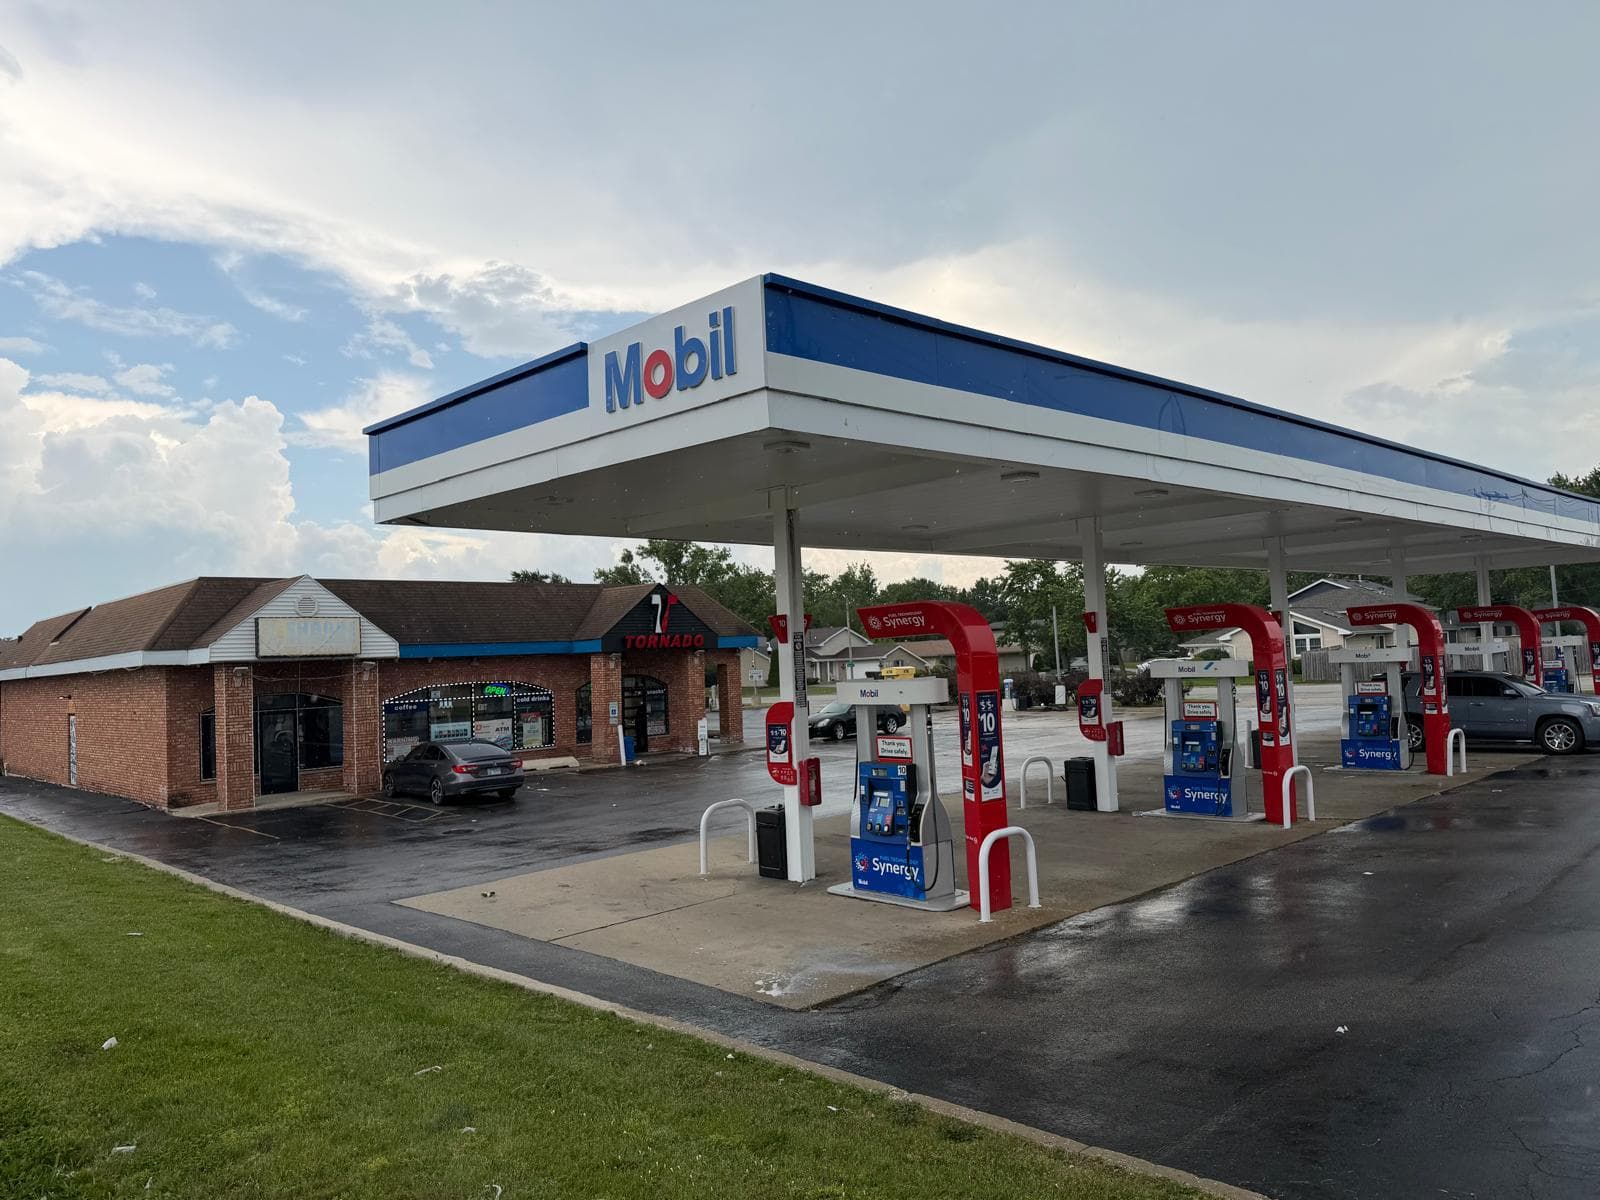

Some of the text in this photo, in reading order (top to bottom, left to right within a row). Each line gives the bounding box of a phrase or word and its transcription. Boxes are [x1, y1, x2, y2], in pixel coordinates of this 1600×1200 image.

[604, 305, 737, 414] Mobil
[1187, 613, 1227, 624] Synergy
[1363, 611, 1398, 620] Synergy
[778, 619, 786, 627] 10
[882, 615, 926, 629] Synergy
[624, 634, 704, 649] TORNADO
[1177, 665, 1196, 673] Mobil
[484, 685, 507, 696] OPEN
[859, 688, 879, 698] Mobil
[394, 703, 418, 711] coffee
[897, 766, 907, 776] 10
[1184, 788, 1228, 804] Synergy
[872, 857, 920, 882] Synergy
